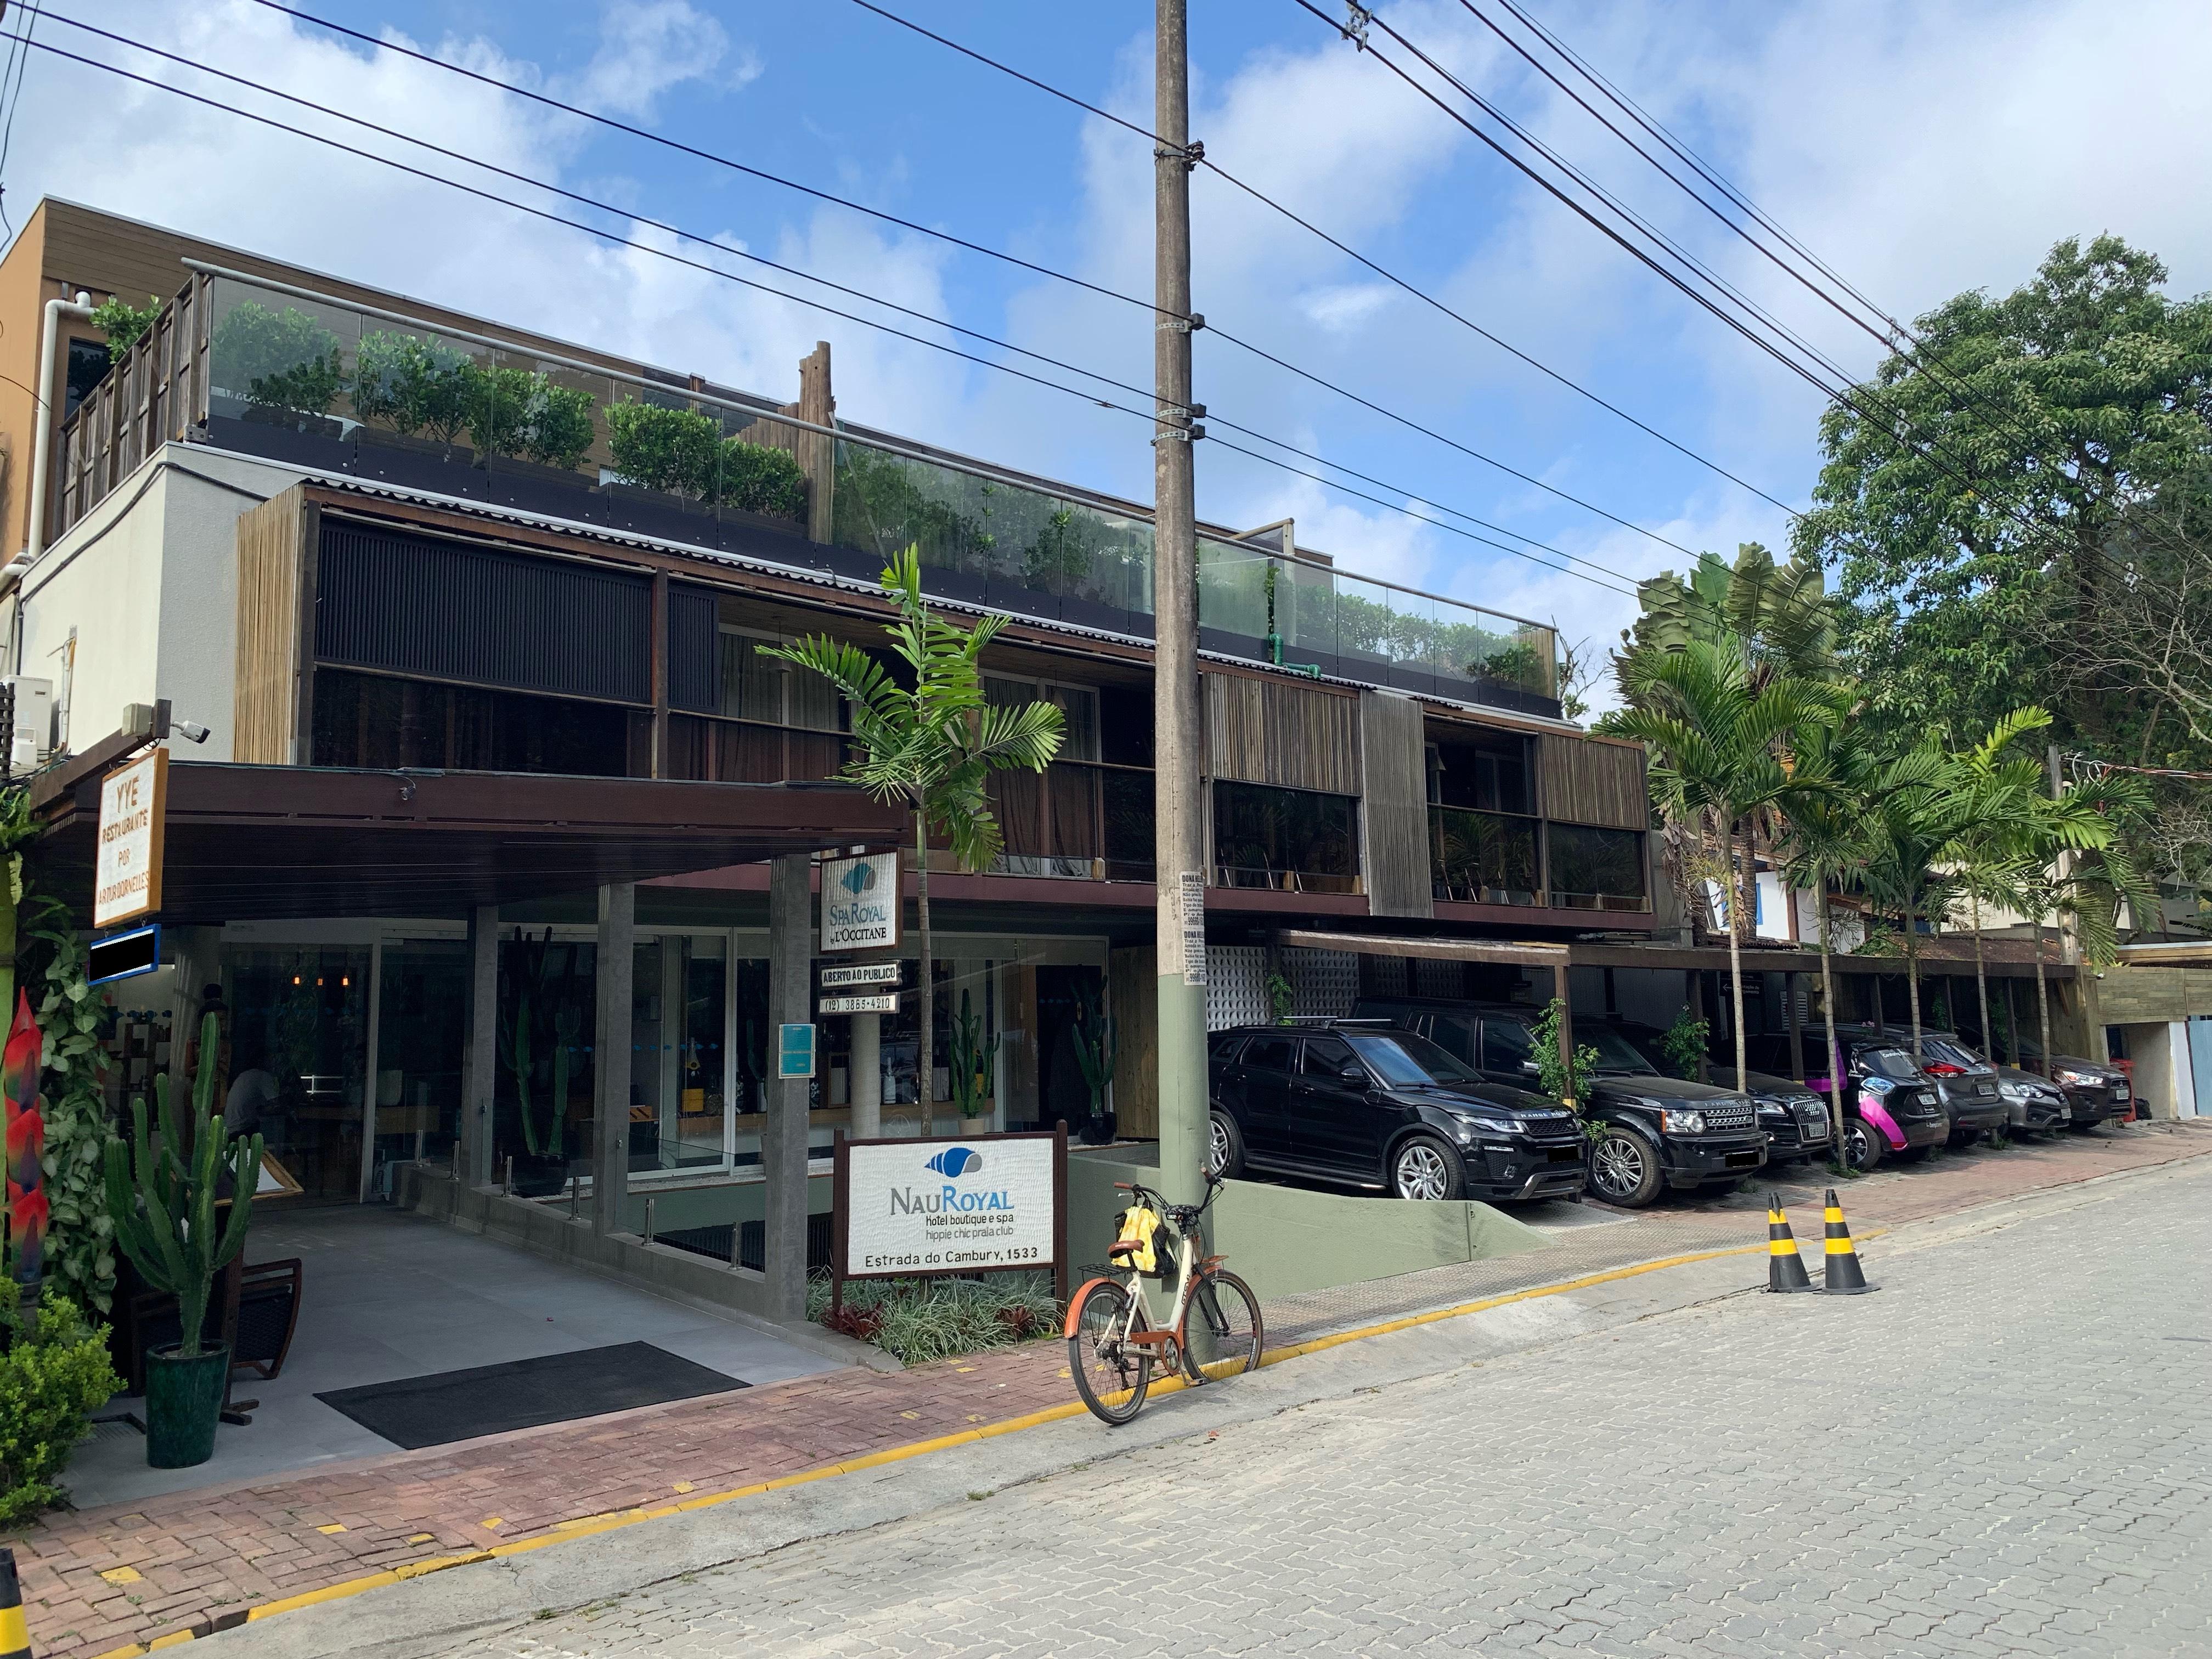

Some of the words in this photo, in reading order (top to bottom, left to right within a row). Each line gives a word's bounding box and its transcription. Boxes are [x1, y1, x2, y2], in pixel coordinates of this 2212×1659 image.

[118, 848, 130, 867] POR
[823, 970, 850, 983] ABERTO
[852, 969, 861, 980] AO
[864, 967, 895, 980] PUBLICO
[826, 999, 839, 1012] (12)
[926, 1215, 947, 1226] hotel
[950, 1215, 986, 1226] boutique
[996, 1214, 1014, 1224] spa
[926, 1229, 952, 1243] hippie
[954, 1228, 970, 1239] chic
[972, 1227, 994, 1240] praia
[996, 1226, 1014, 1236] club
[866, 1254, 920, 1267] Estrada
[925, 1252, 940, 1263] do
[946, 1250, 1003, 1262] Cambury,
[1007, 1247, 1038, 1260] 1533
